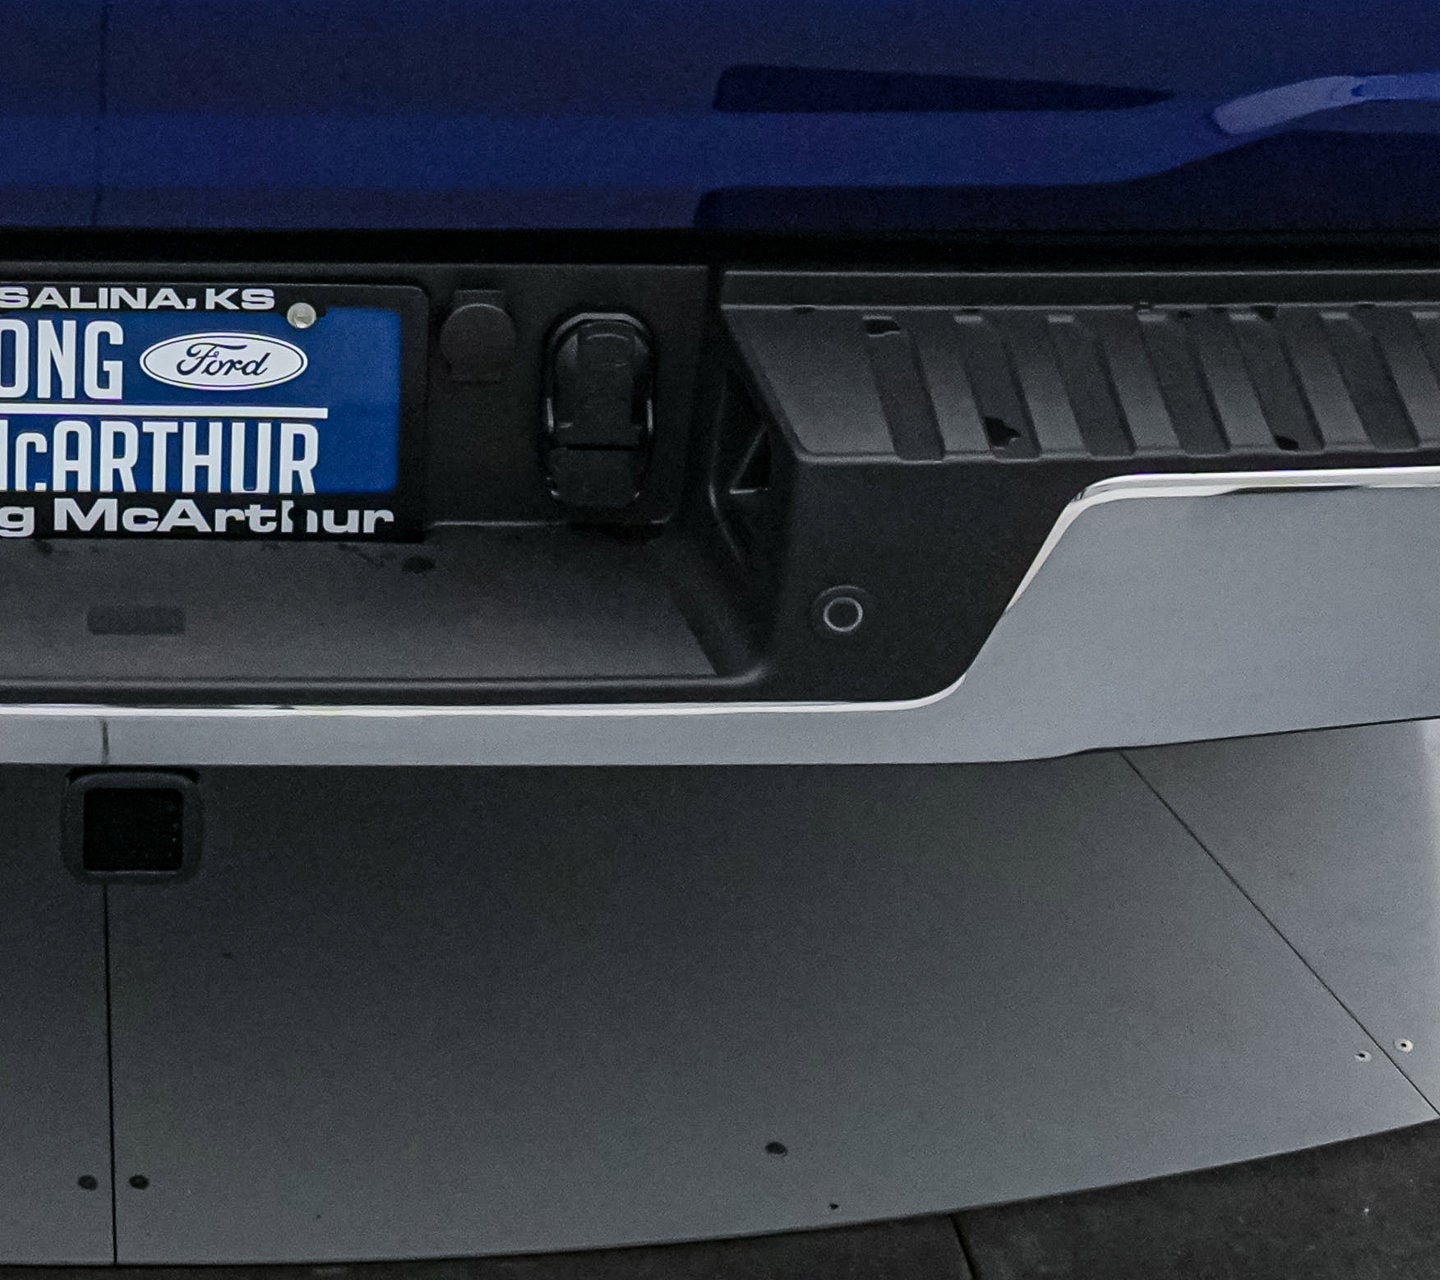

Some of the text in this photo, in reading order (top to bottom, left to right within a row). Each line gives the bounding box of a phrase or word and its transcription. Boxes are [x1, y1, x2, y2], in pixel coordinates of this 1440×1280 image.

[204, 287, 275, 311] KS
[175, 341, 271, 376] Ford
[53, 496, 395, 534] McArthur
